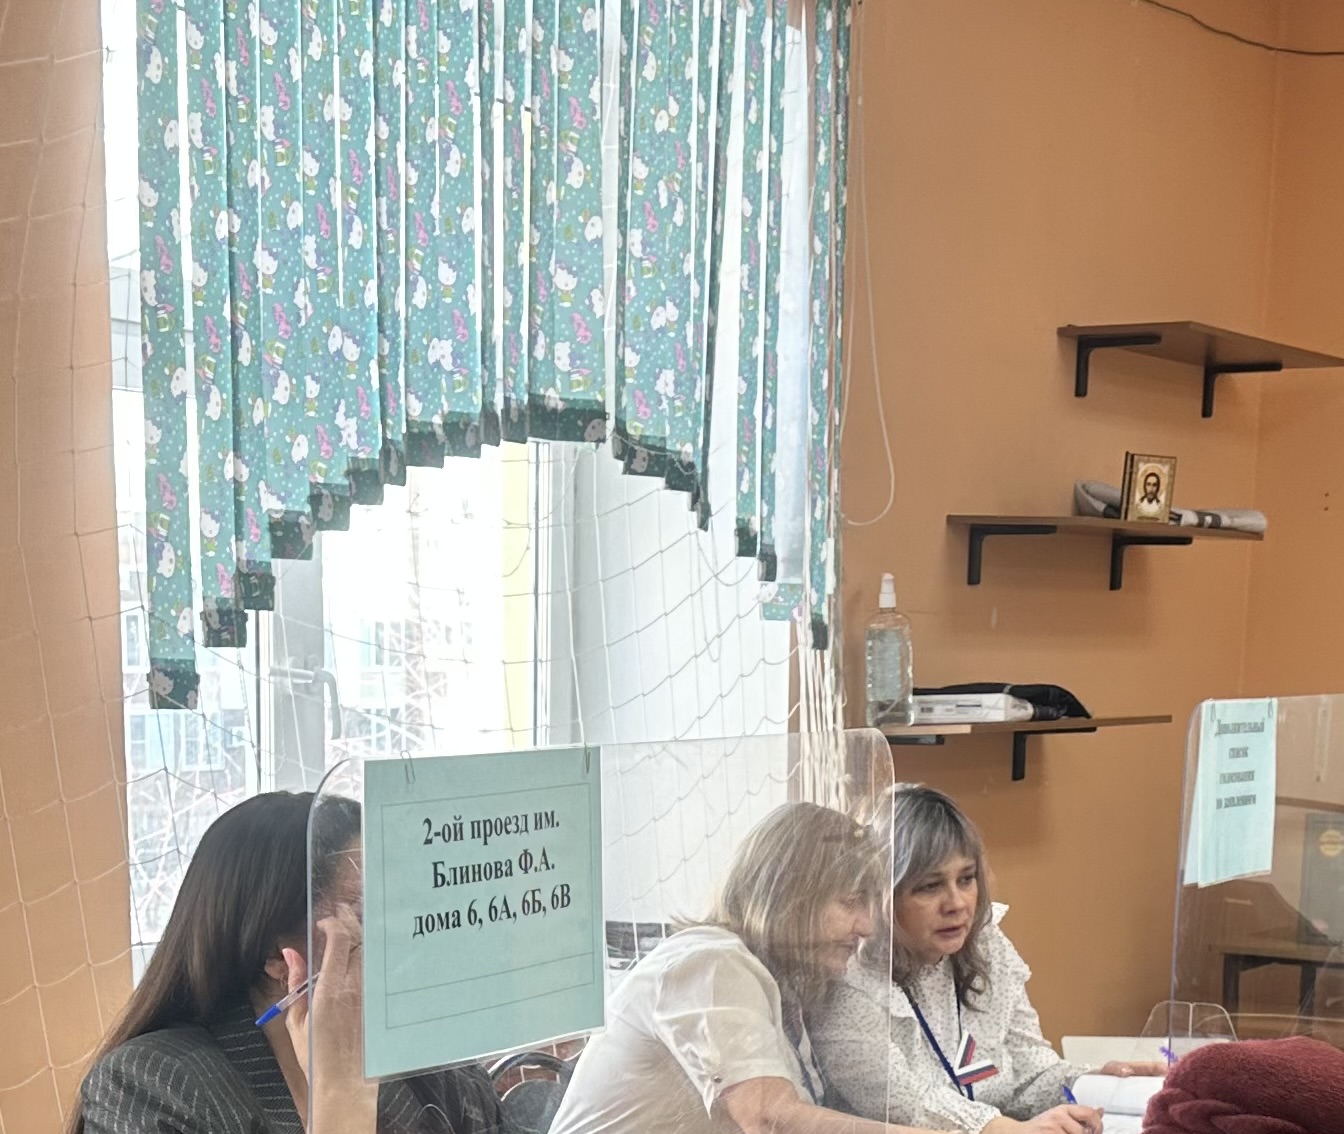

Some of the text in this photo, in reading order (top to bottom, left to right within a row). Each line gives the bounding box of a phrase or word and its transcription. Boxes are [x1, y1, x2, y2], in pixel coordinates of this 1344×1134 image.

[422, 810, 560, 846] 2-ой проезд им.
[432, 846, 555, 889] Блинова Ф.А.
[412, 883, 572, 939] дома 6, 6А, 6Б, 6В
